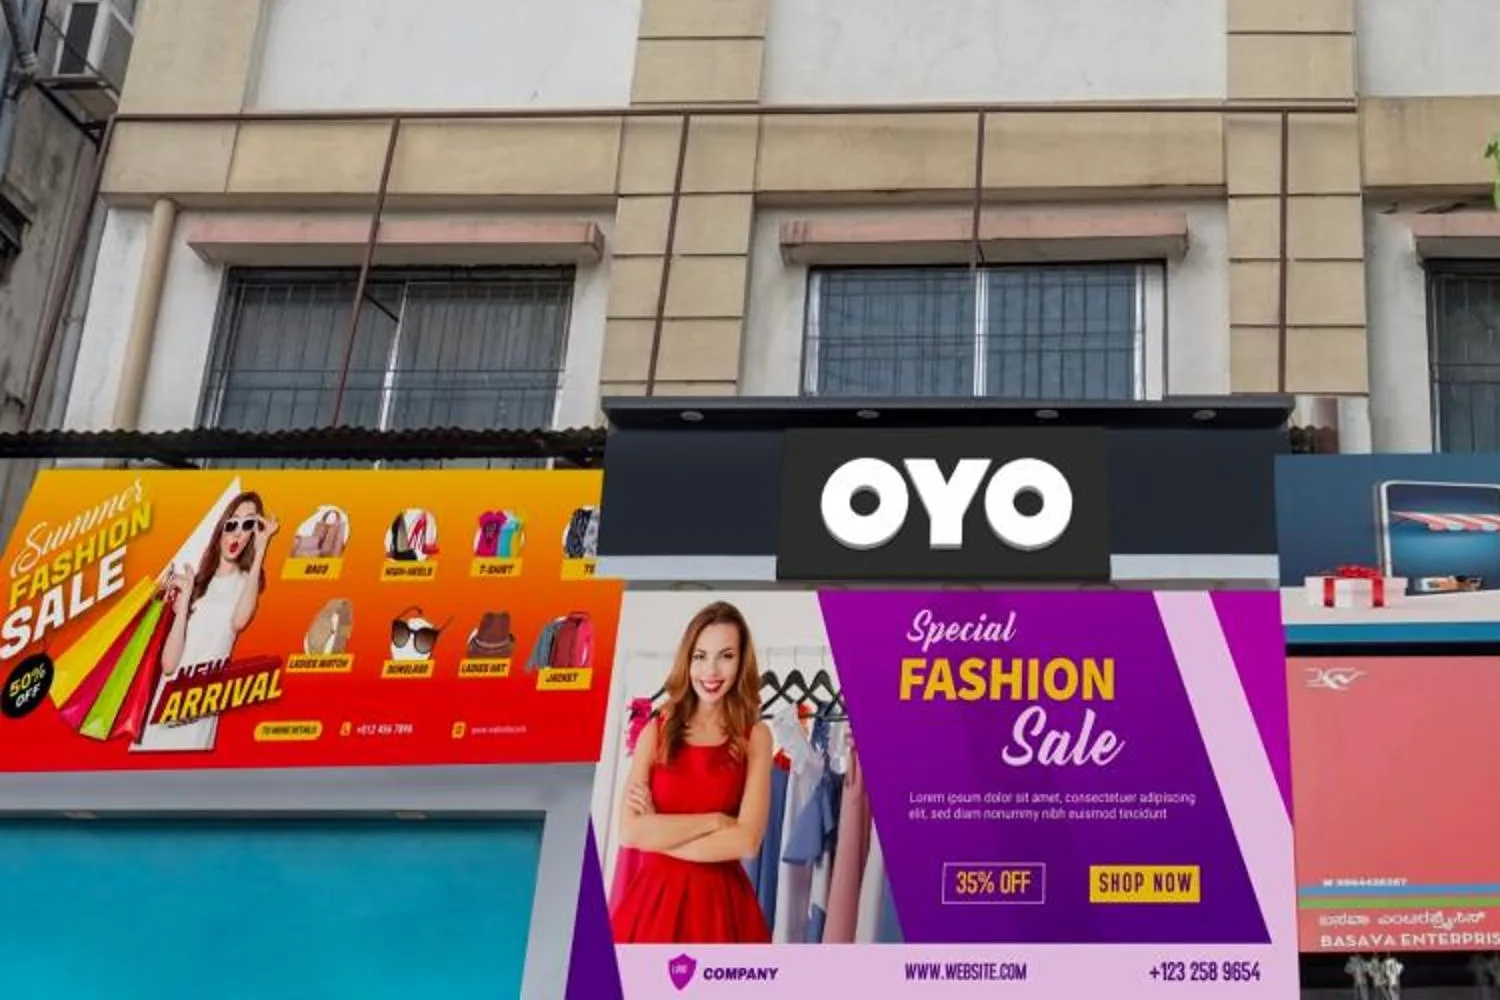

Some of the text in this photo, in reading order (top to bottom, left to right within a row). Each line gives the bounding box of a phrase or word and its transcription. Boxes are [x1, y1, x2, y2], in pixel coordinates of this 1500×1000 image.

[820, 457, 1073, 551] OYO
[10, 478, 143, 578] Summer
[9, 500, 151, 611] FASHION
[479, 563, 514, 575] T-SHIRT
[0, 544, 128, 660] SALE
[906, 609, 1017, 652] Special
[9, 662, 46, 697] 50%
[545, 673, 579, 683] JACKET
[900, 656, 1116, 701] FASHION
[15, 683, 41, 708] OFF
[160, 668, 283, 724] ARRIVAL
[1001, 705, 1127, 767] Sale
[909, 791, 945, 803] Lorem
[948, 792, 981, 806] ipsum
[984, 792, 1013, 803] dolor
[1015, 792, 1030, 803] sit
[1065, 792, 1137, 803] consectetuer
[1139, 792, 1196, 806] adipiscing
[930, 808, 950, 820] sed
[954, 808, 981, 820] diam
[984, 809, 1039, 822] nonummy
[1042, 808, 1065, 819] nibh
[1068, 807, 1117, 819] euismod
[1119, 807, 1168, 819] tincidunt
[956, 869, 1032, 894] 35% OFF
[1099, 872, 1192, 892] SHOP NOW
[1320, 933, 1397, 947] BASAVA
[703, 967, 779, 981] COMPANY
[904, 962, 1027, 981] WWW.WEBSITE.COM
[1149, 961, 1261, 981] +123 258 9654
